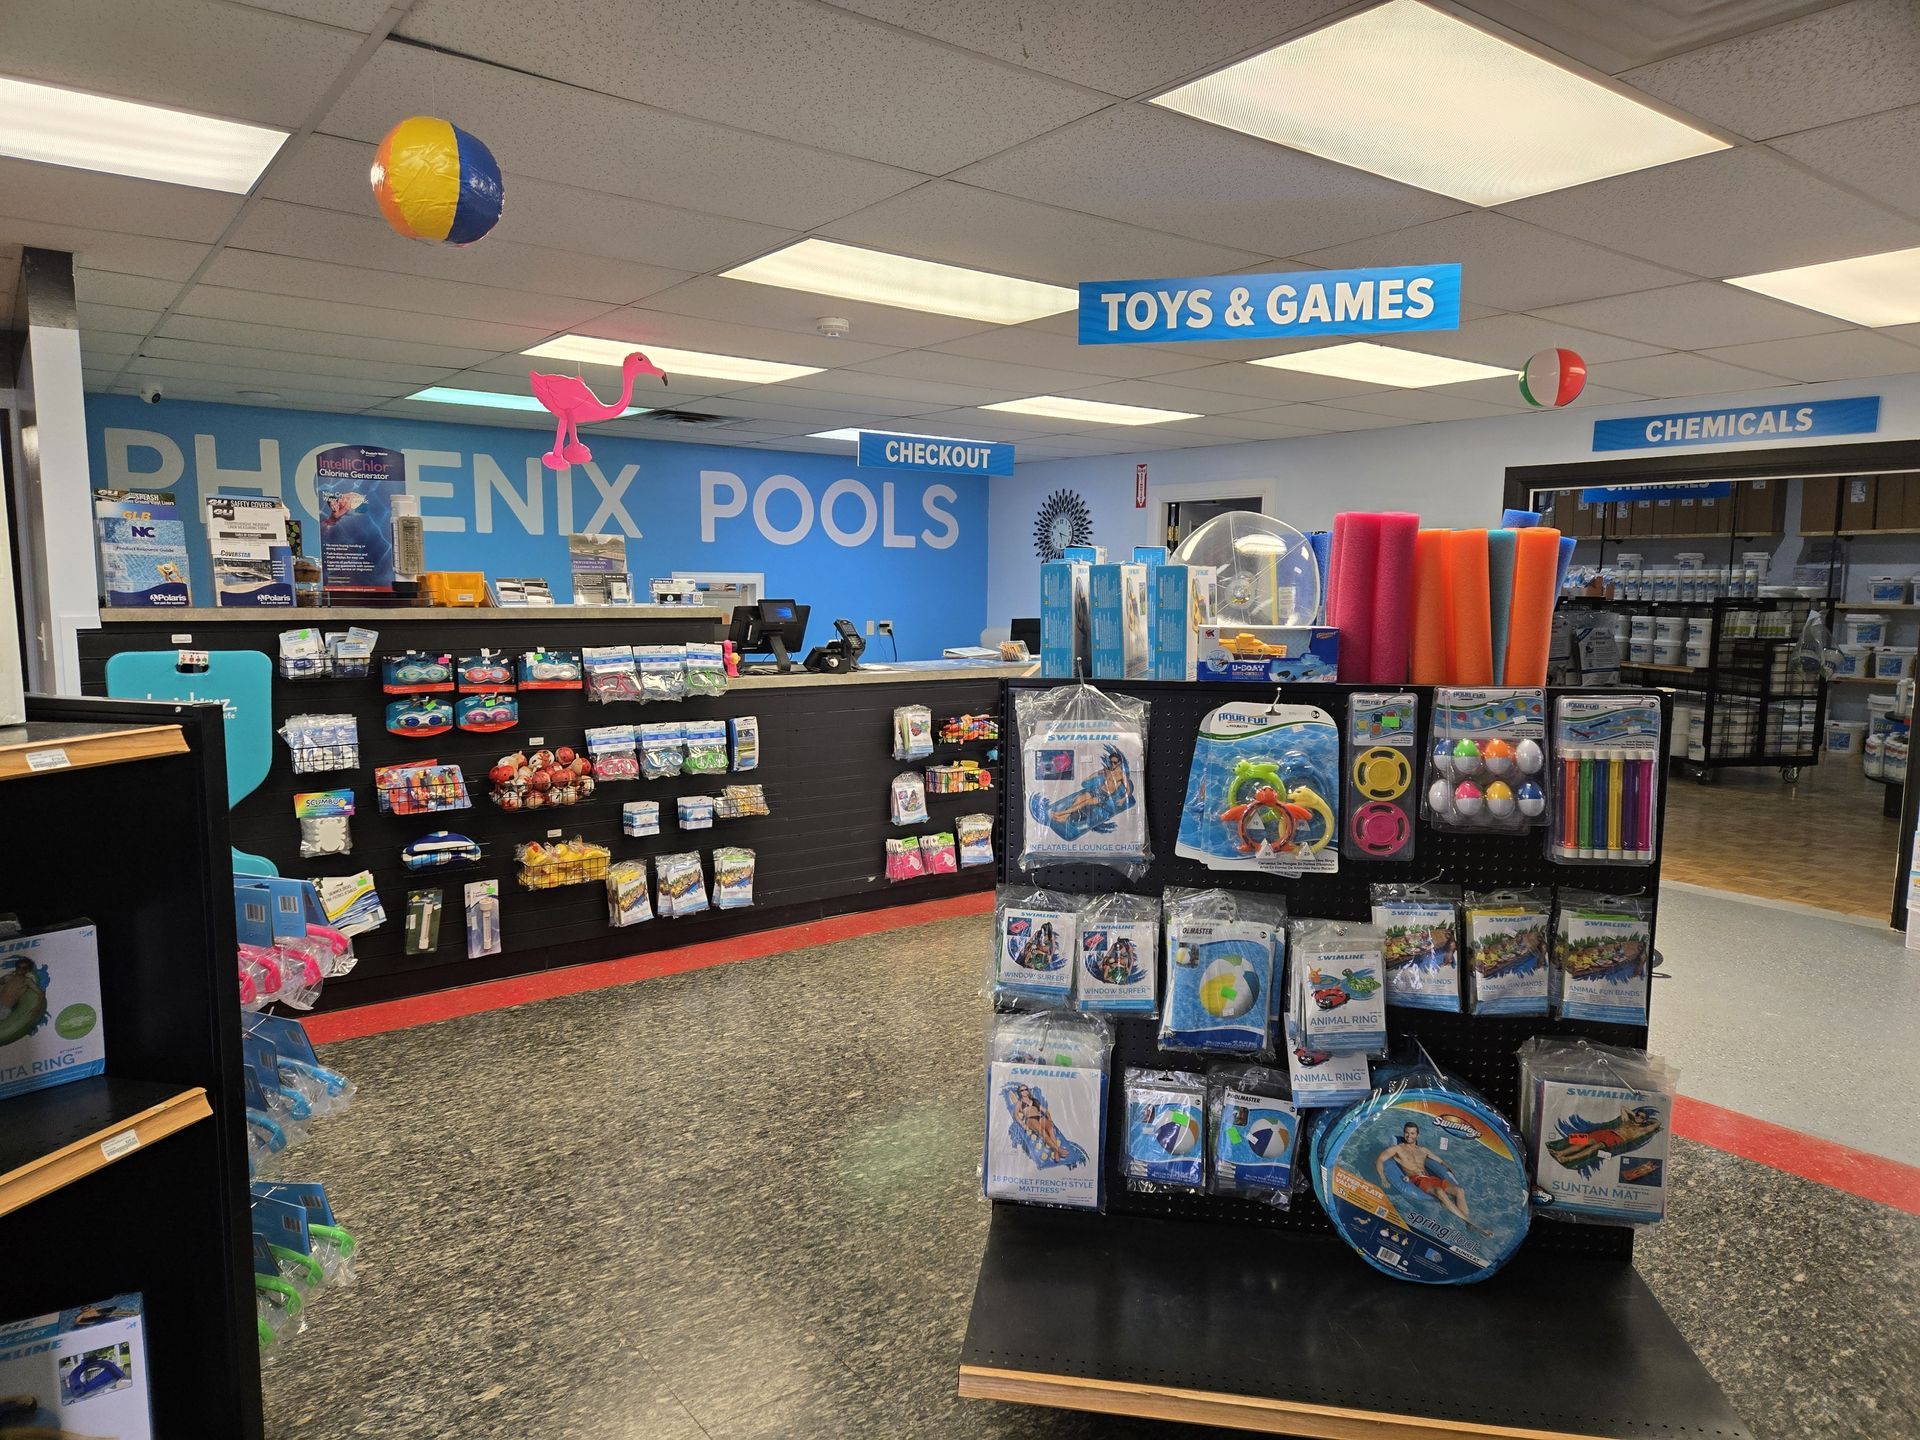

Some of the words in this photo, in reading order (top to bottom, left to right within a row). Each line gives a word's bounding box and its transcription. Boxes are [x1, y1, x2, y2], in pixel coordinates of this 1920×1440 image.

[1101, 288, 1213, 331] TOYS
[1225, 287, 1255, 327] &
[1266, 277, 1435, 325] GAMES
[1645, 407, 1813, 442] CHEMICALS
[885, 440, 991, 469] CHECKOUT
[320, 456, 387, 472] IntelliChlor
[319, 468, 349, 478] Chlorine
[350, 471, 389, 480] Generator
[700, 470, 960, 549] POOLS
[131, 526, 156, 538] NC
[220, 550, 251, 558] COVERSTAR
[1219, 713, 1246, 722] AQUA
[1247, 715, 1268, 725] FUN
[1079, 843, 1112, 851] LOUNGE
[1584, 920, 1633, 928] SWIMLINE
[1004, 971, 1037, 979] WINDOW
[1084, 987, 1117, 995] WINDOW
[1570, 985, 1598, 995] ANIMAL
[1310, 1015, 1349, 1026] ANIMAL
[1352, 1015, 1378, 1024] RING
[32, 1053, 75, 1074] RING
[1011, 1067, 1080, 1079] SWIMLINE
[1294, 1072, 1334, 1082] ANIMAL
[1336, 1072, 1362, 1082] RING
[1566, 1087, 1649, 1101] SWIMLINE
[1433, 1116, 1482, 1138] SwimWays
[1003, 1175, 1035, 1186] POCKET
[1036, 1178, 1066, 1187] FRENCH
[1066, 1180, 1094, 1189] STYLE
[1552, 1181, 1610, 1197] SUNTAN
